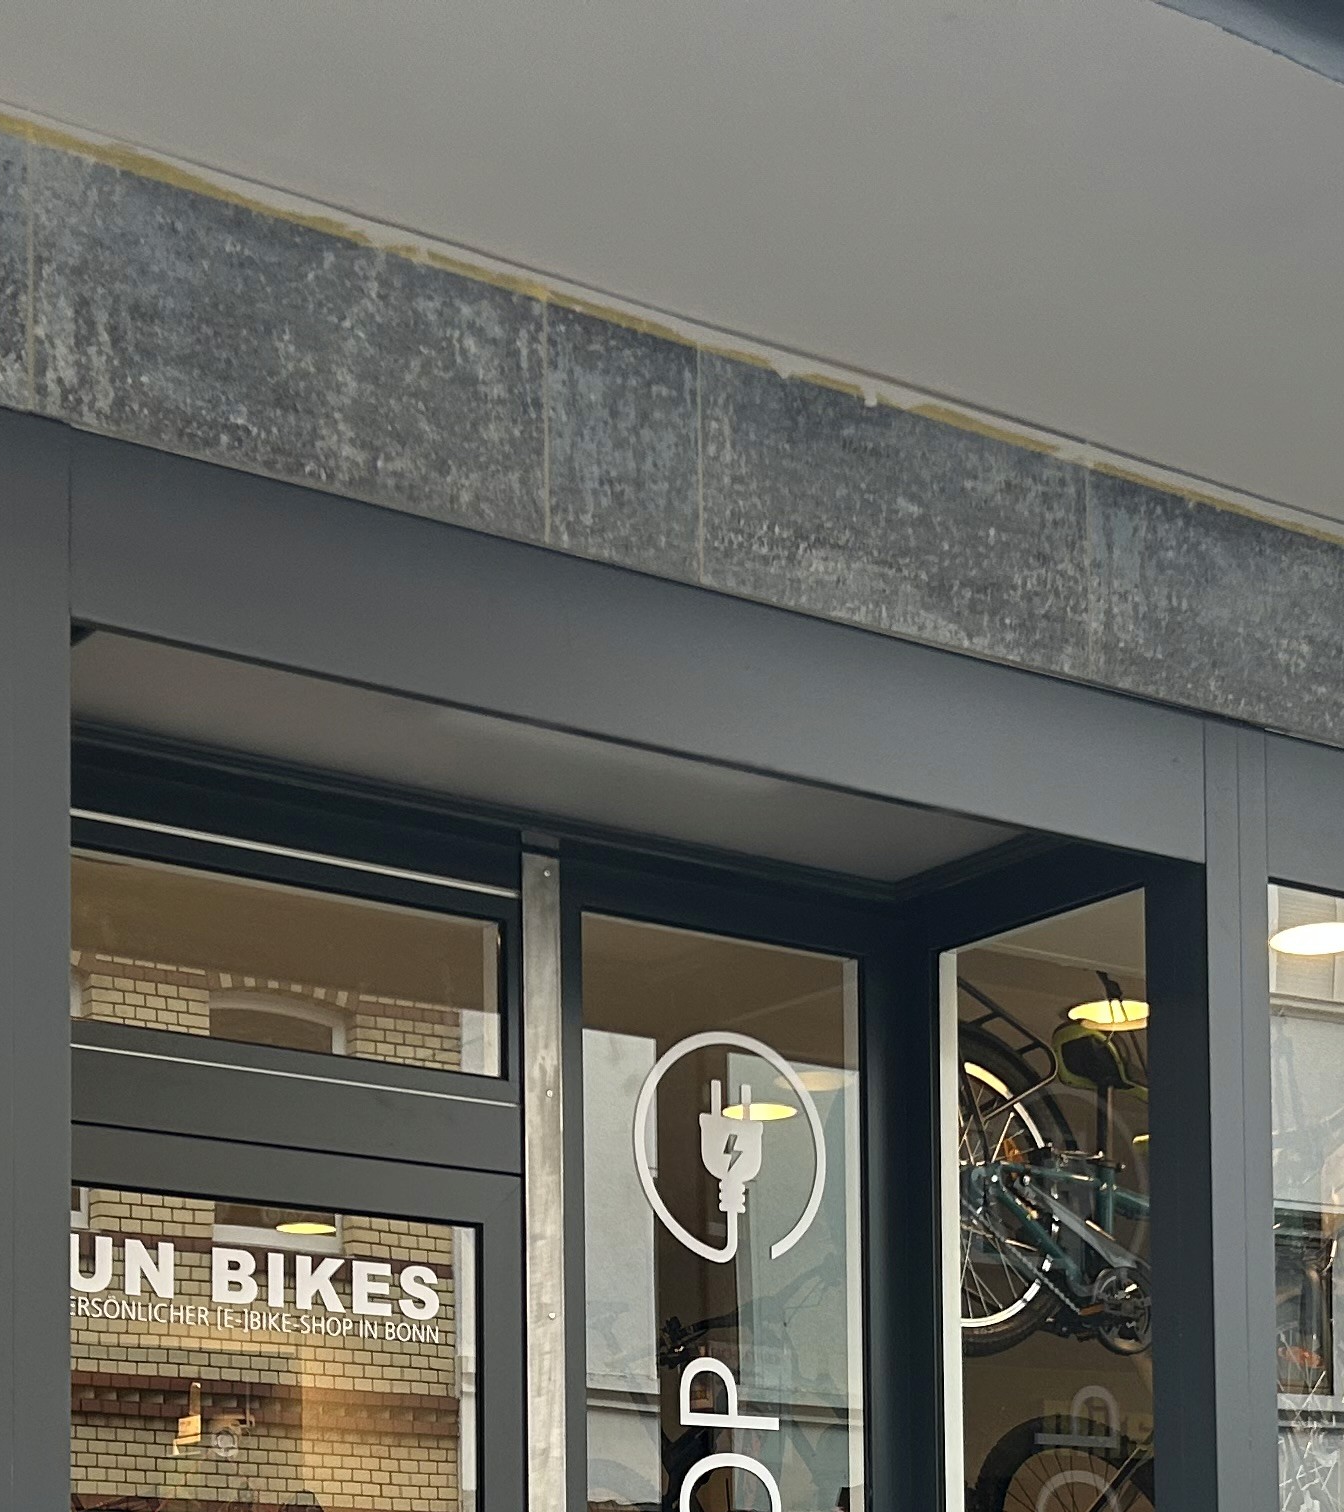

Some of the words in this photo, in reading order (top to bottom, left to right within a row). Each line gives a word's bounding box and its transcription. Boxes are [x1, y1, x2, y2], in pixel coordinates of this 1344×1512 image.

[212, 1247, 441, 1320] BIKES
[216, 1307, 353, 1338] [E-]BIKE-SHOP
[359, 1320, 379, 1340] IN
[384, 1322, 440, 1345] BONN
